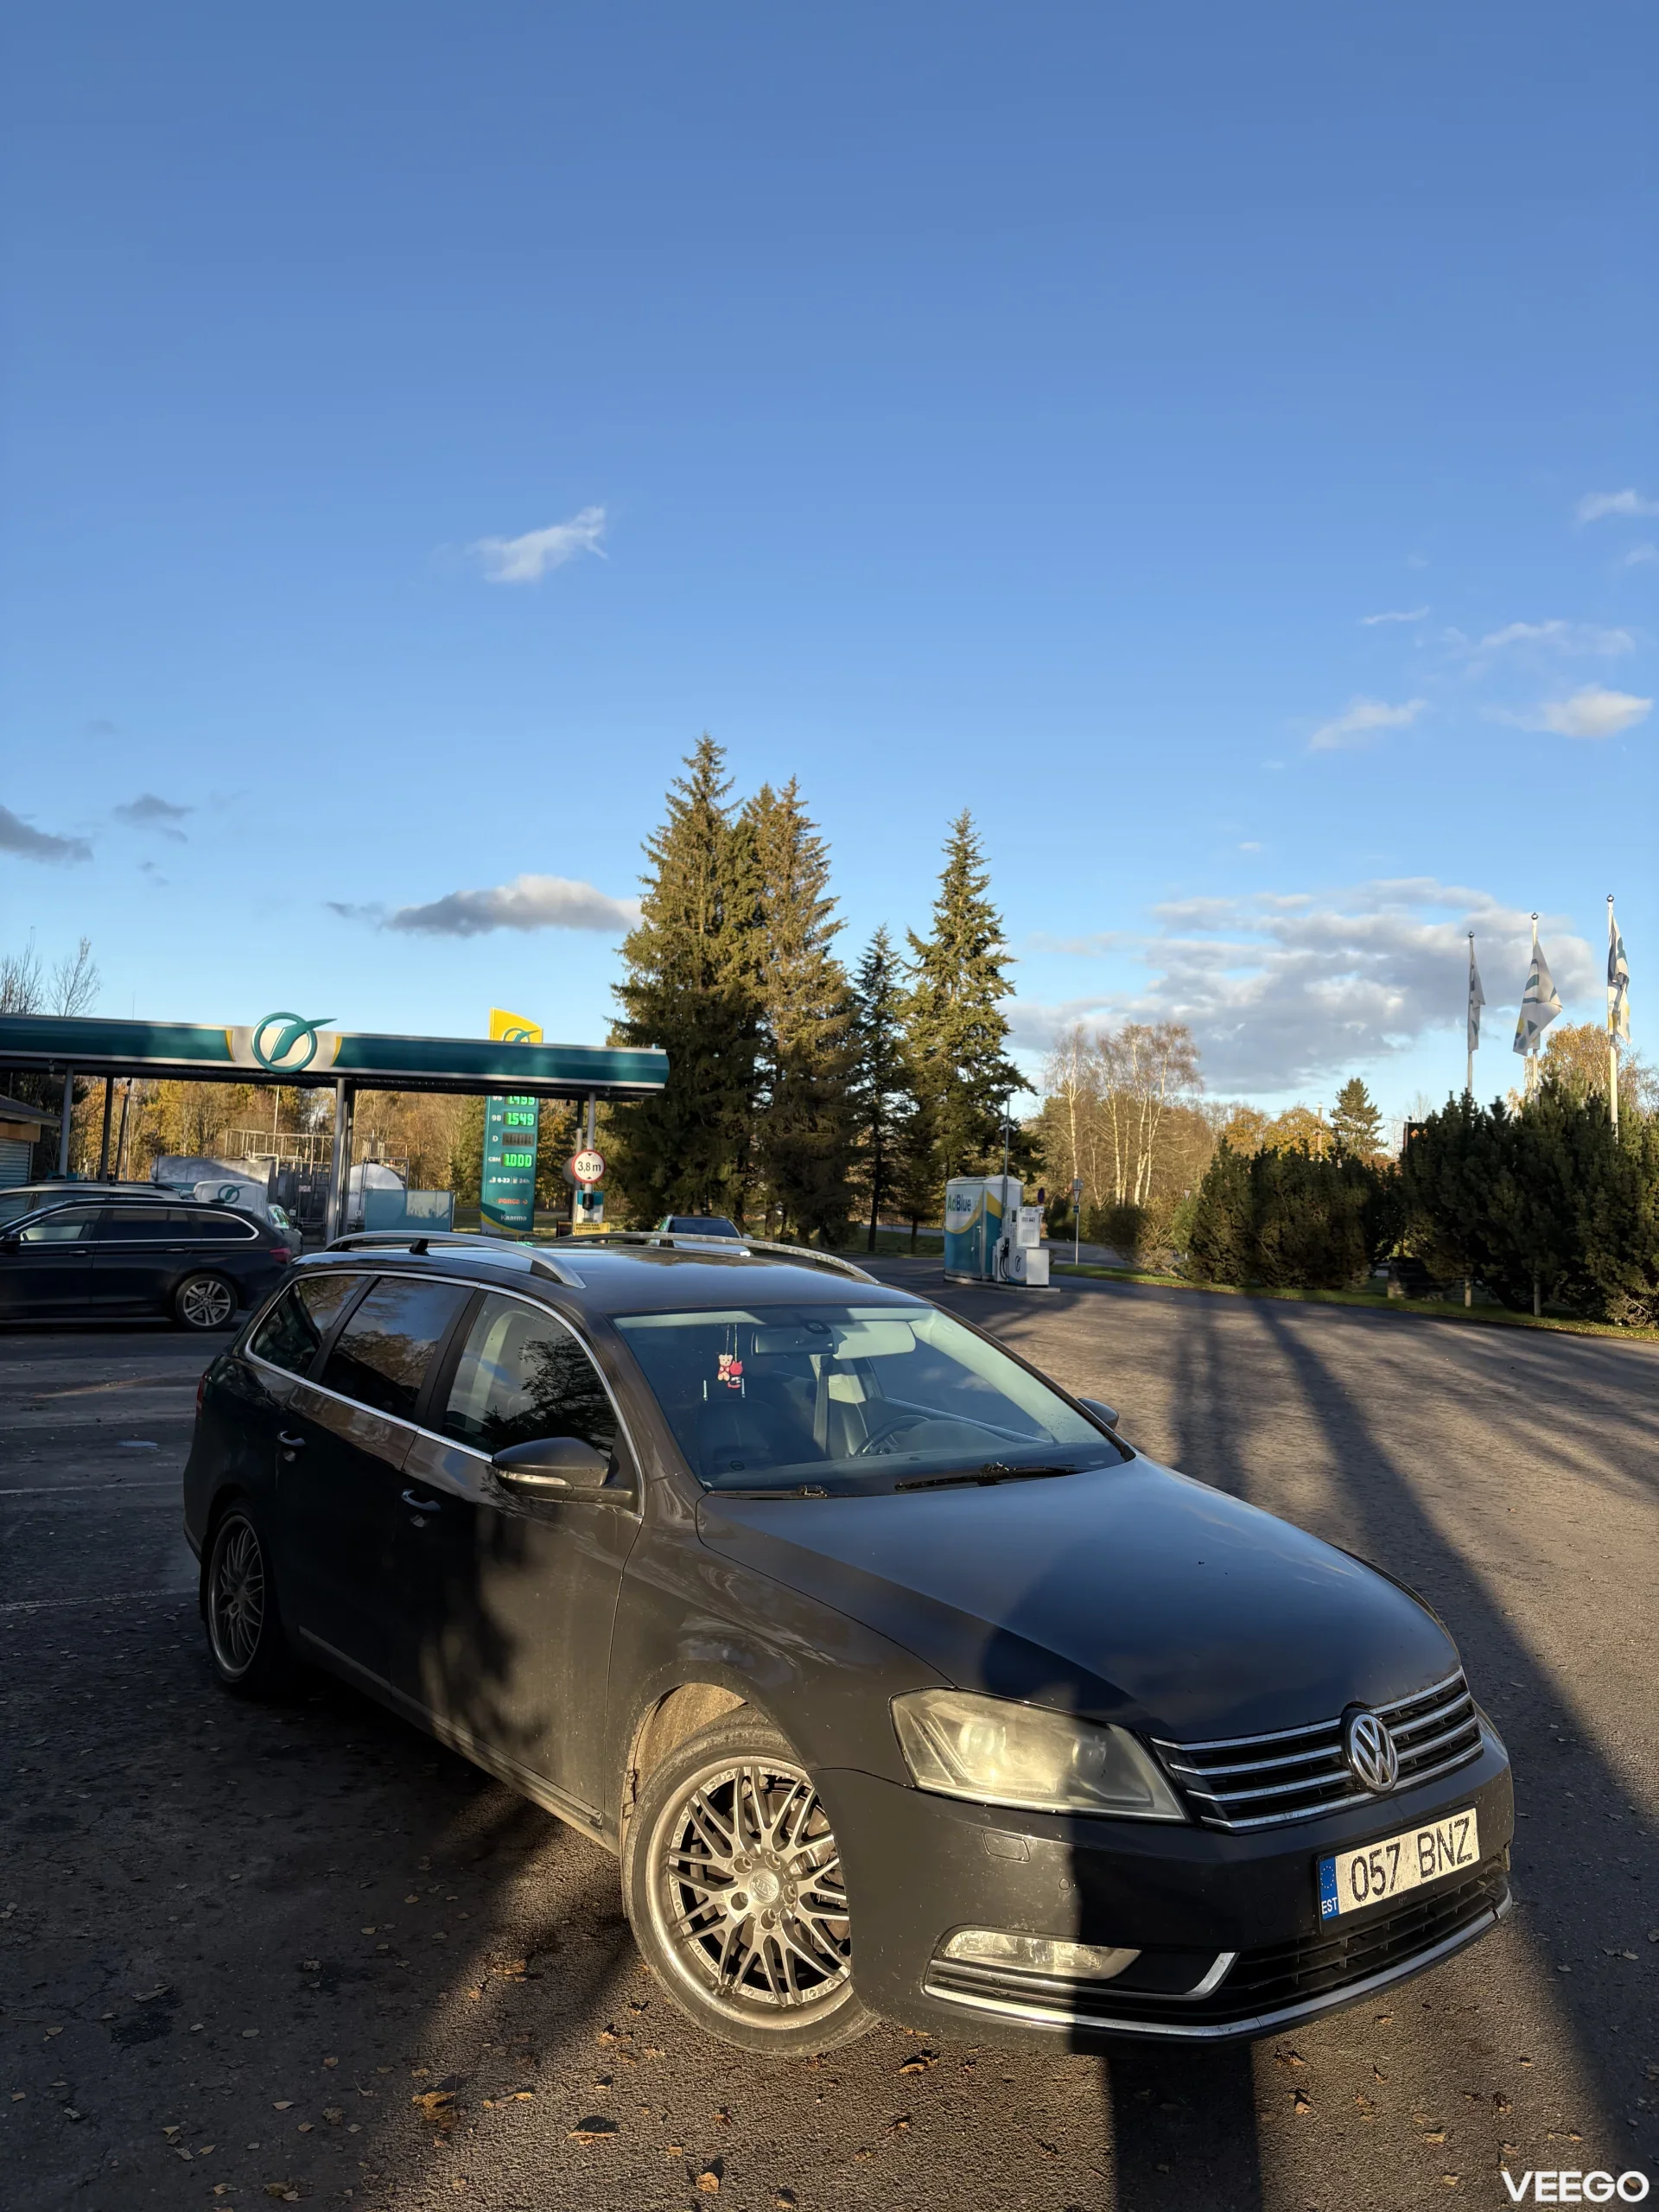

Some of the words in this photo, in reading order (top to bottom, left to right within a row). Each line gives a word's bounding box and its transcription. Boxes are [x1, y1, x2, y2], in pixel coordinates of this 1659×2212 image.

[947, 1193, 972, 1212] AdBlue
[1351, 1842, 1401, 1902] 057
[1417, 1816, 1473, 1879] BNZ
[1321, 1897, 1338, 1915] EST
